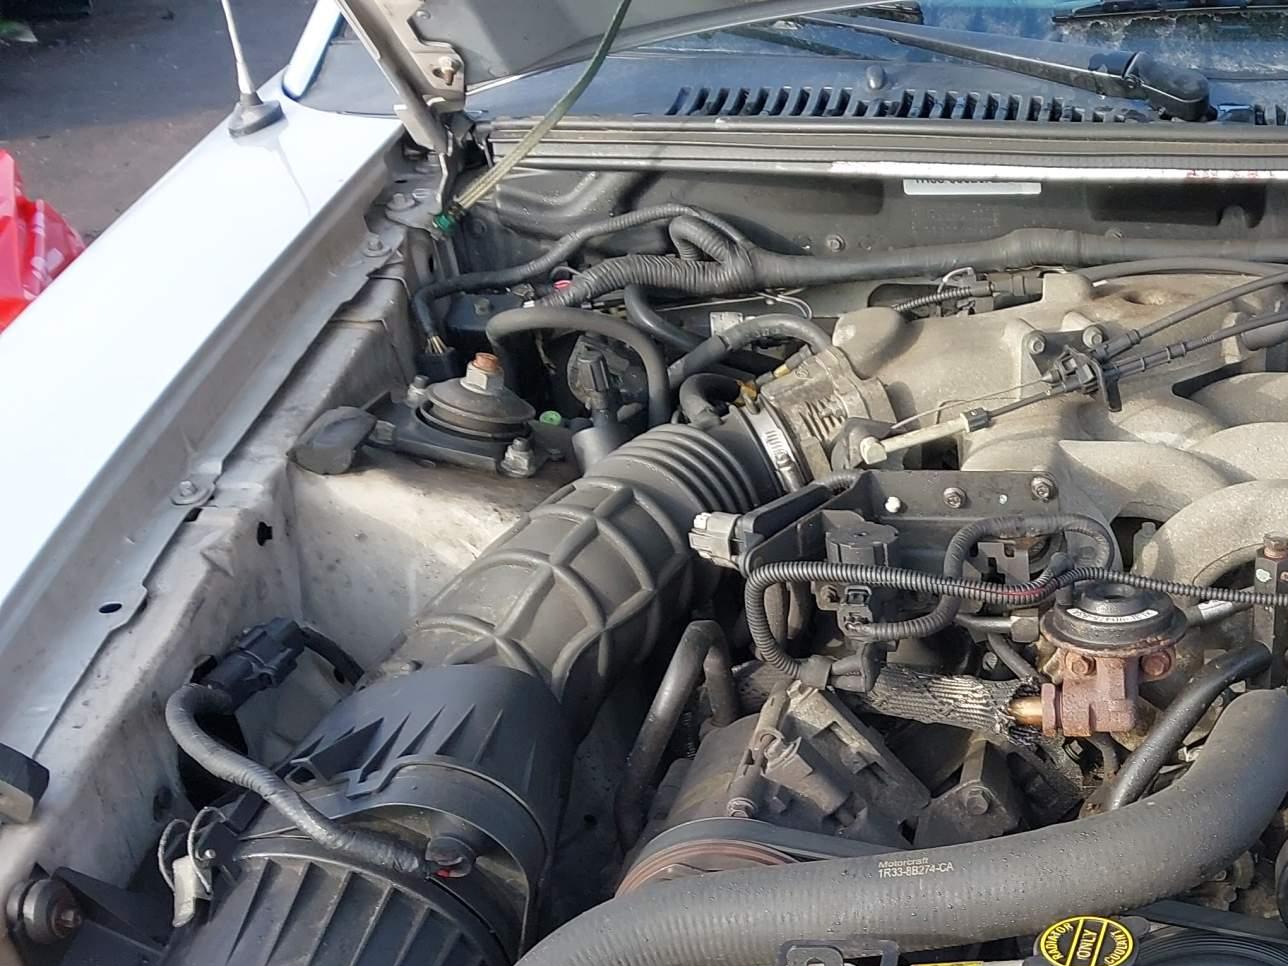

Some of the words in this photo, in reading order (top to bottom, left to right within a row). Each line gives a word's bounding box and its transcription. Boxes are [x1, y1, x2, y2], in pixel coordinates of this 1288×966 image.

[879, 857, 929, 869] Motorcraft
[1046, 922, 1074, 961] RADIATOR
[1077, 929, 1098, 960] ONLY
[1104, 930, 1129, 965] COOLANT
